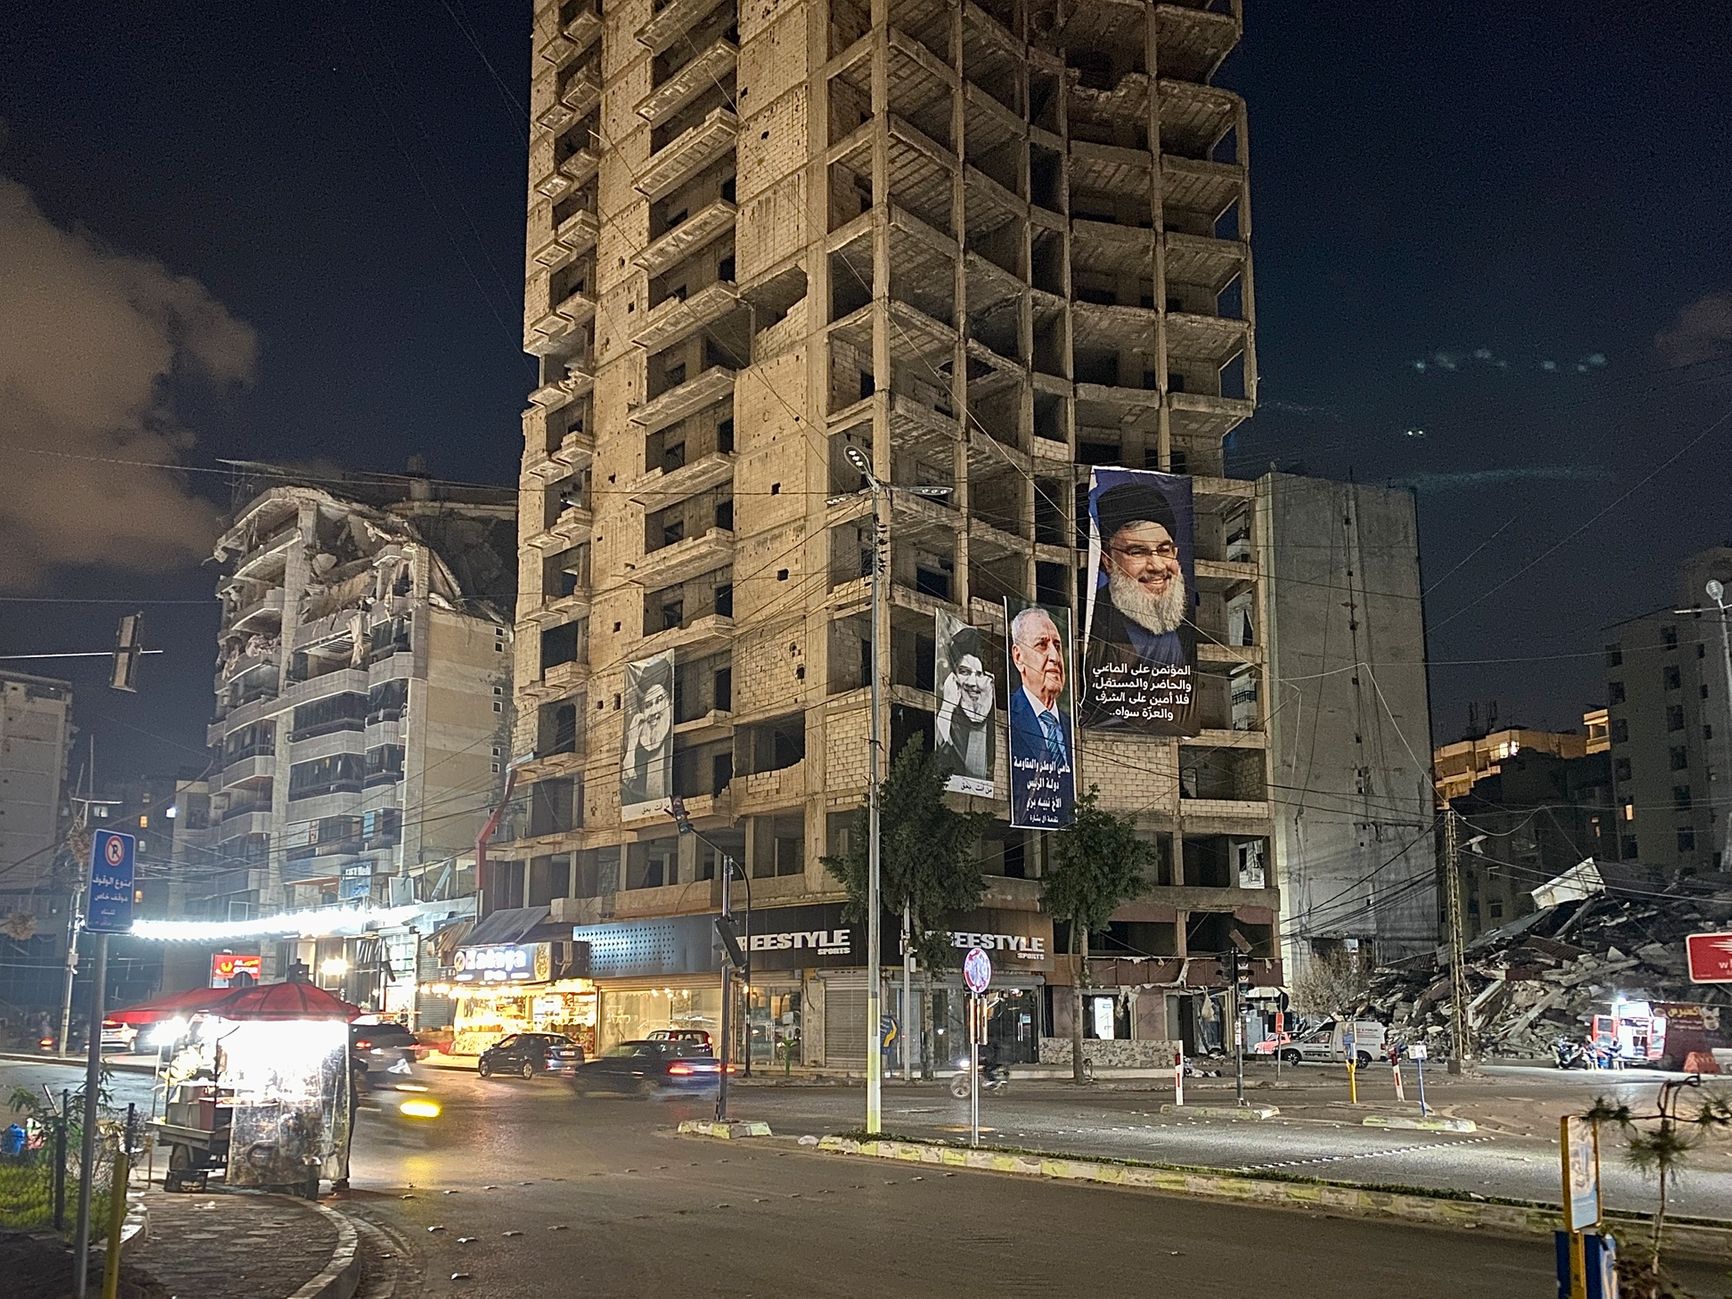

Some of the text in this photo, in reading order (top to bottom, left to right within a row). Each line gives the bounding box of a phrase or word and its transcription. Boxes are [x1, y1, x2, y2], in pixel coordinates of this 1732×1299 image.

[1092, 662, 1191, 677] المؤتمن على الماضي
[1150, 679, 1192, 692] والحاضر
[1095, 690, 1190, 706] فلا أمين على الشرف
[1046, 777, 1060, 792] دولة
[735, 929, 851, 952] REESTYLE
